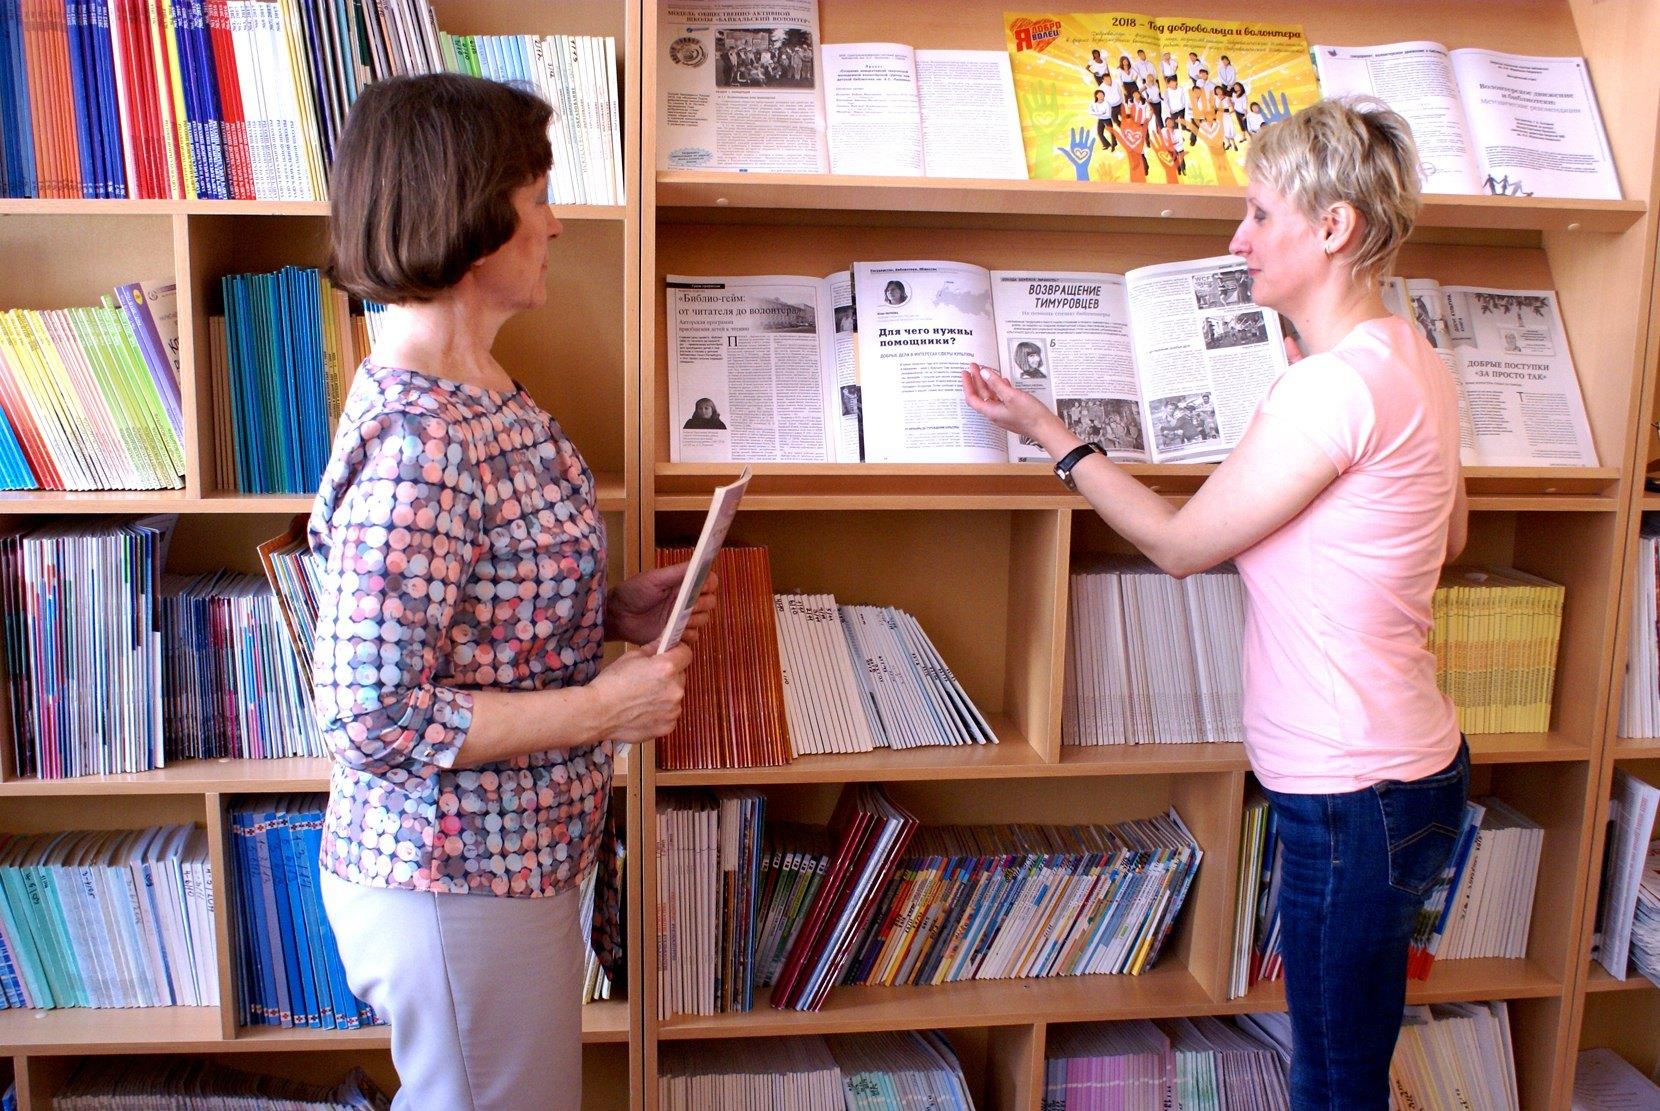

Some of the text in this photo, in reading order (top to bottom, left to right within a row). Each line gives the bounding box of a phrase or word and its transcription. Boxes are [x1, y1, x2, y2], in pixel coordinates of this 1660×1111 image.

[1032, 21, 1062, 34] ДОБРО
[1112, 17, 1137, 28] 2018
[1147, 20, 1165, 34] Год
[1167, 23, 1234, 37] добровольца
[1244, 27, 1301, 40] волонтера
[1014, 28, 1033, 52] Я
[1032, 30, 1060, 41] ВОЛЕЦ
[1028, 284, 1101, 296] ВОЗВРАЩЕНИЕ
[1034, 298, 1099, 310] ТИМУРОВЦЕВ
[692, 308, 734, 316] читателя
[736, 308, 748, 316] до
[879, 327, 973, 338] Для чего нужны
[728, 336, 738, 347] П
[880, 337, 956, 347] помощники?
[1467, 361, 1550, 371] ДОБРЫЕ ПОСТУПКИ
[1492, 371, 1525, 379] ПРОСТО
